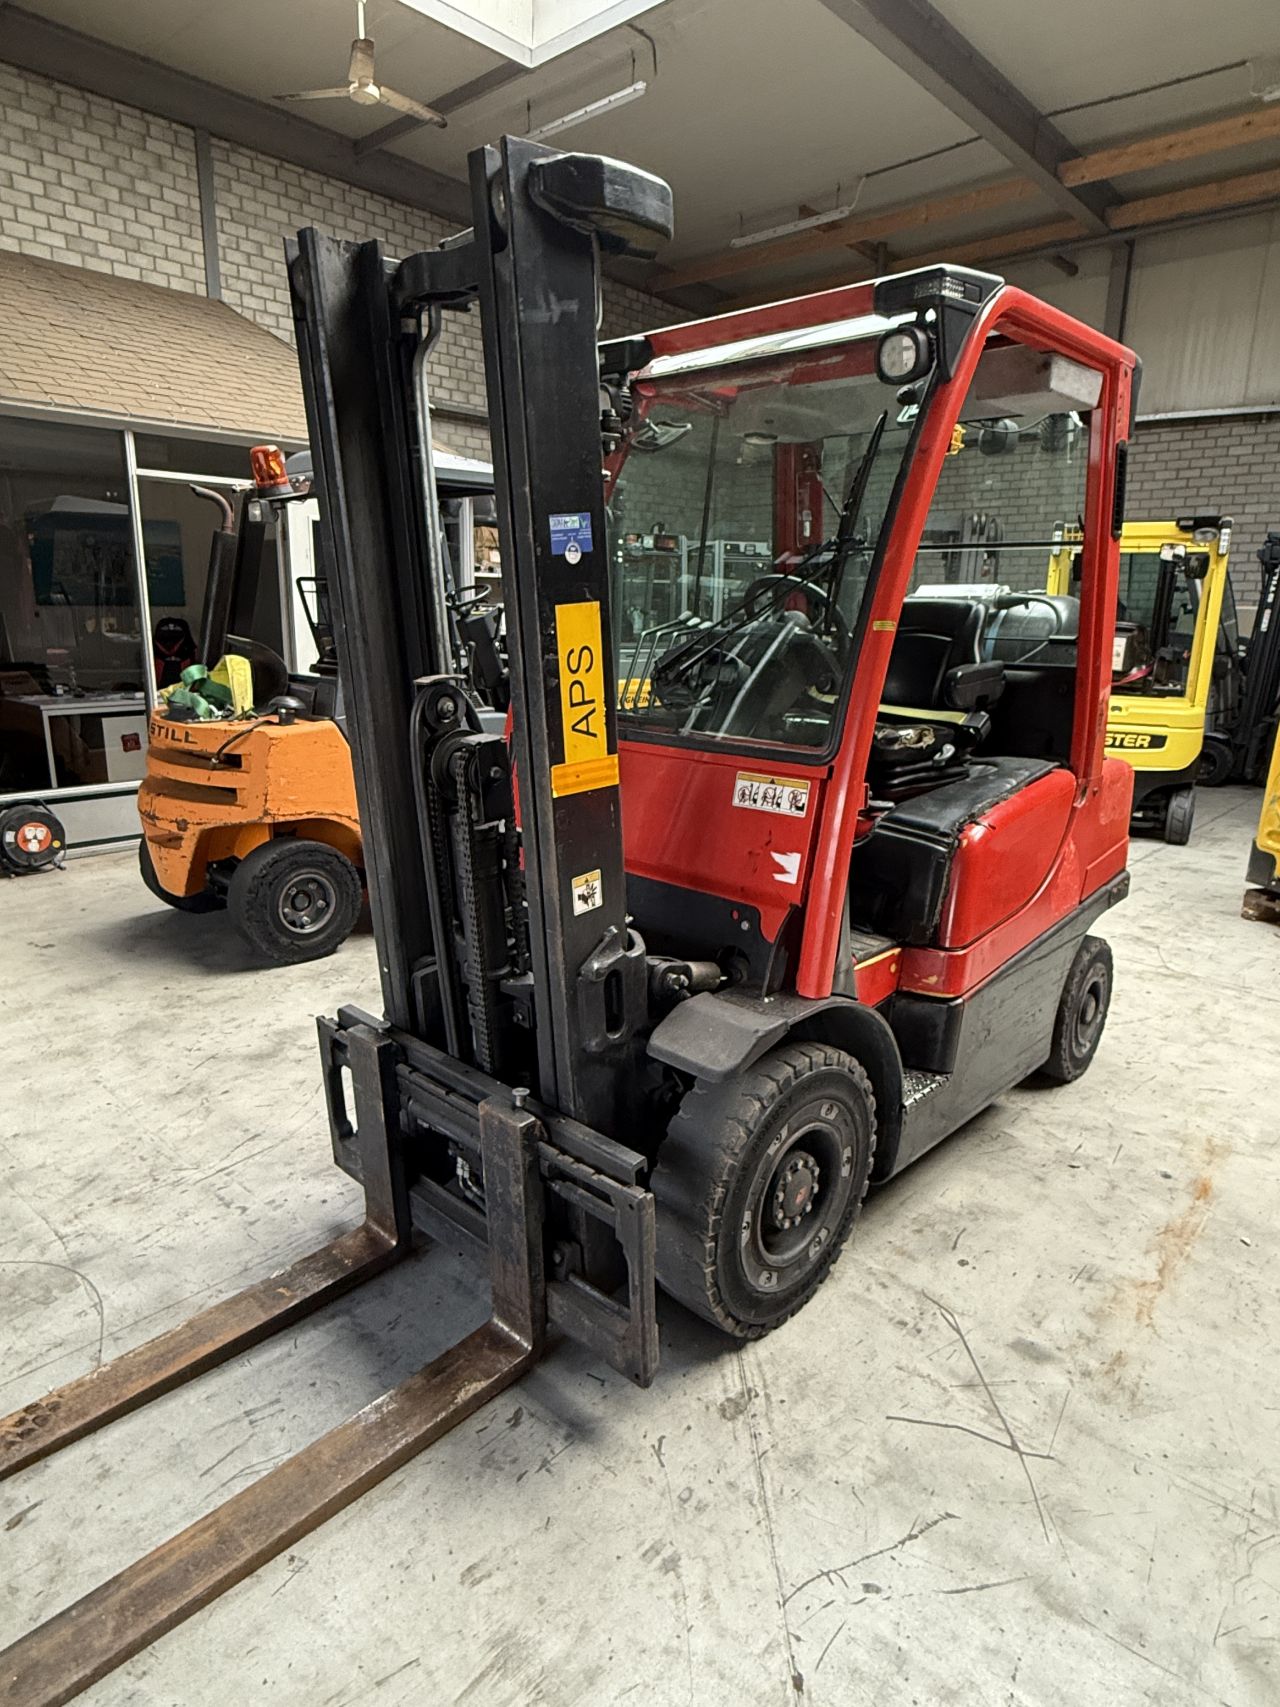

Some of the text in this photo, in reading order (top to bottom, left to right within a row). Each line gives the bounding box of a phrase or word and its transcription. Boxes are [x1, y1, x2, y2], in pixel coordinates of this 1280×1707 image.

[566, 645, 598, 738] APS
[150, 722, 198, 744] STILL
[1104, 733, 1151, 748] STER
